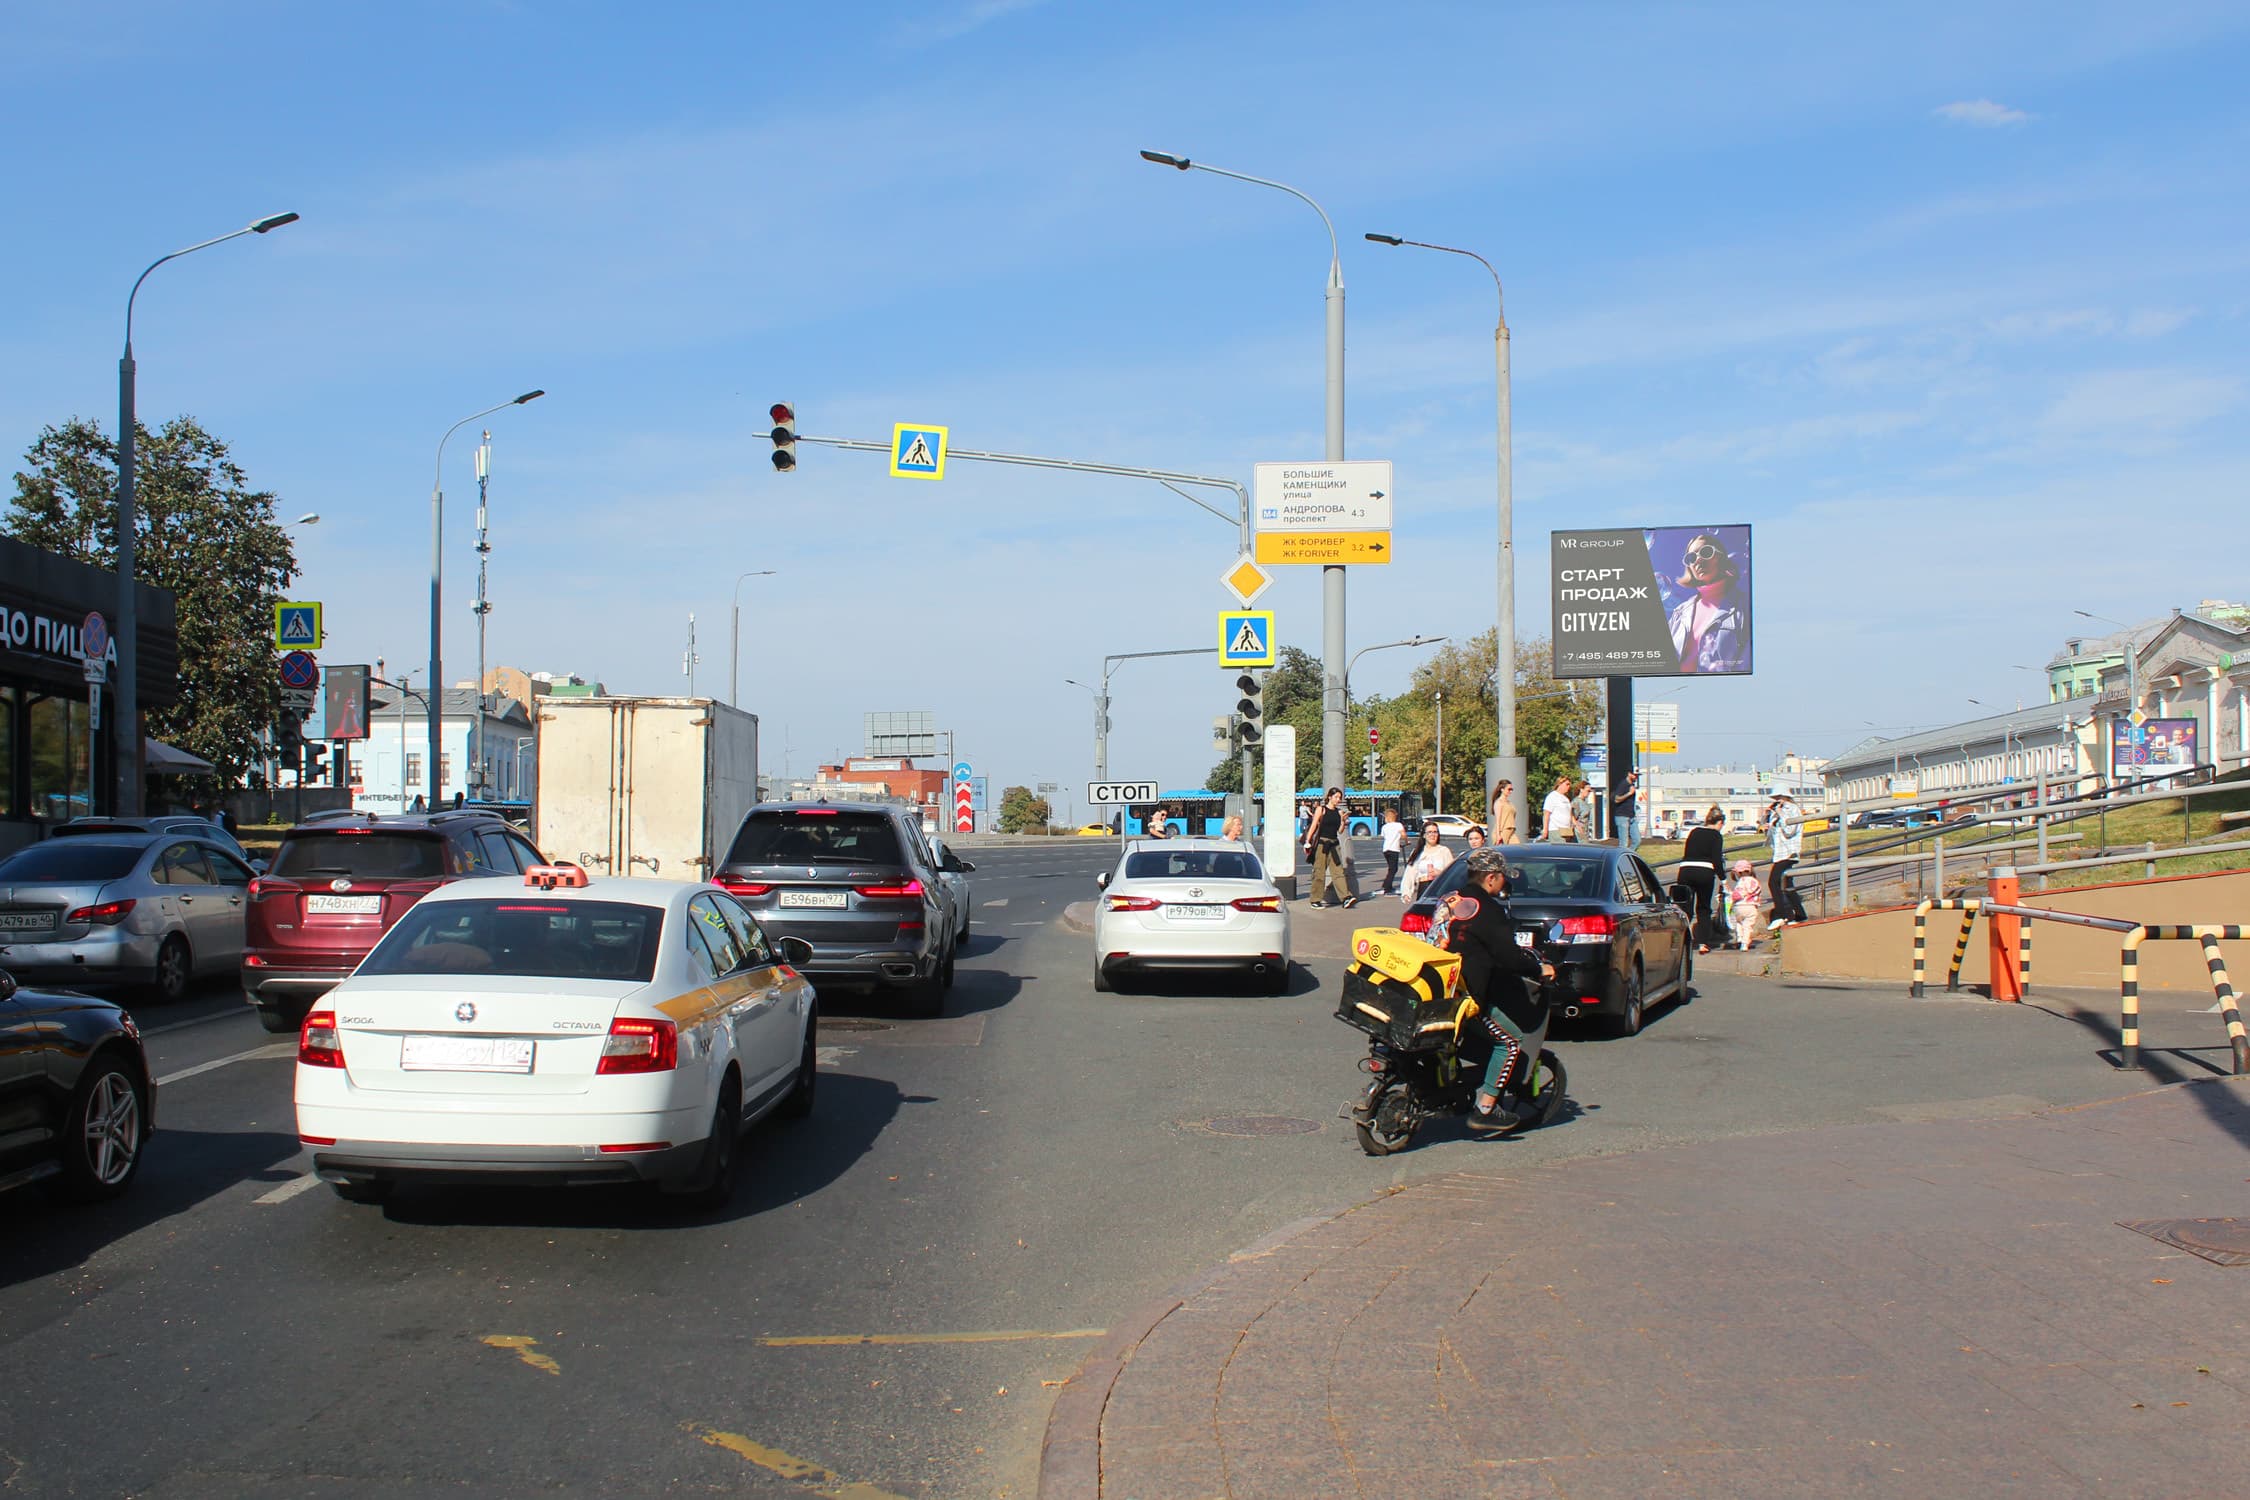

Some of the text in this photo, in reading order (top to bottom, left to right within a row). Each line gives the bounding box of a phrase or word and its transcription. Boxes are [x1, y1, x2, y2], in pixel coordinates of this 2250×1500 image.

[1283, 470, 1334, 479] БОЛЬШИЕ
[1283, 481, 1347, 490] КАМЕНЩИКИ
[1283, 491, 1312, 500] улица
[1283, 505, 1365, 517] АНДРОПОВА 4.3
[1283, 516, 1326, 524] проспект
[1299, 538, 1345, 546] ФОРИВЕР
[1351, 543, 1365, 552] 3.2
[1560, 538, 1625, 549] MR GROUP
[1282, 549, 1340, 558] ЖК FORIVER
[1561, 568, 1625, 582] СТАРТ
[1561, 586, 1649, 602] ПРОДАЖ
[1561, 611, 1630, 632] CITYZEN
[34, 615, 118, 668] ПИЦА
[1576, 651, 1604, 661] (495)
[1605, 651, 1629, 660] 489
[1630, 651, 1645, 659] 75
[1646, 650, 1661, 659] 55
[1096, 785, 1150, 801] СТОП
[552, 1021, 603, 1030] OCTAVIA
